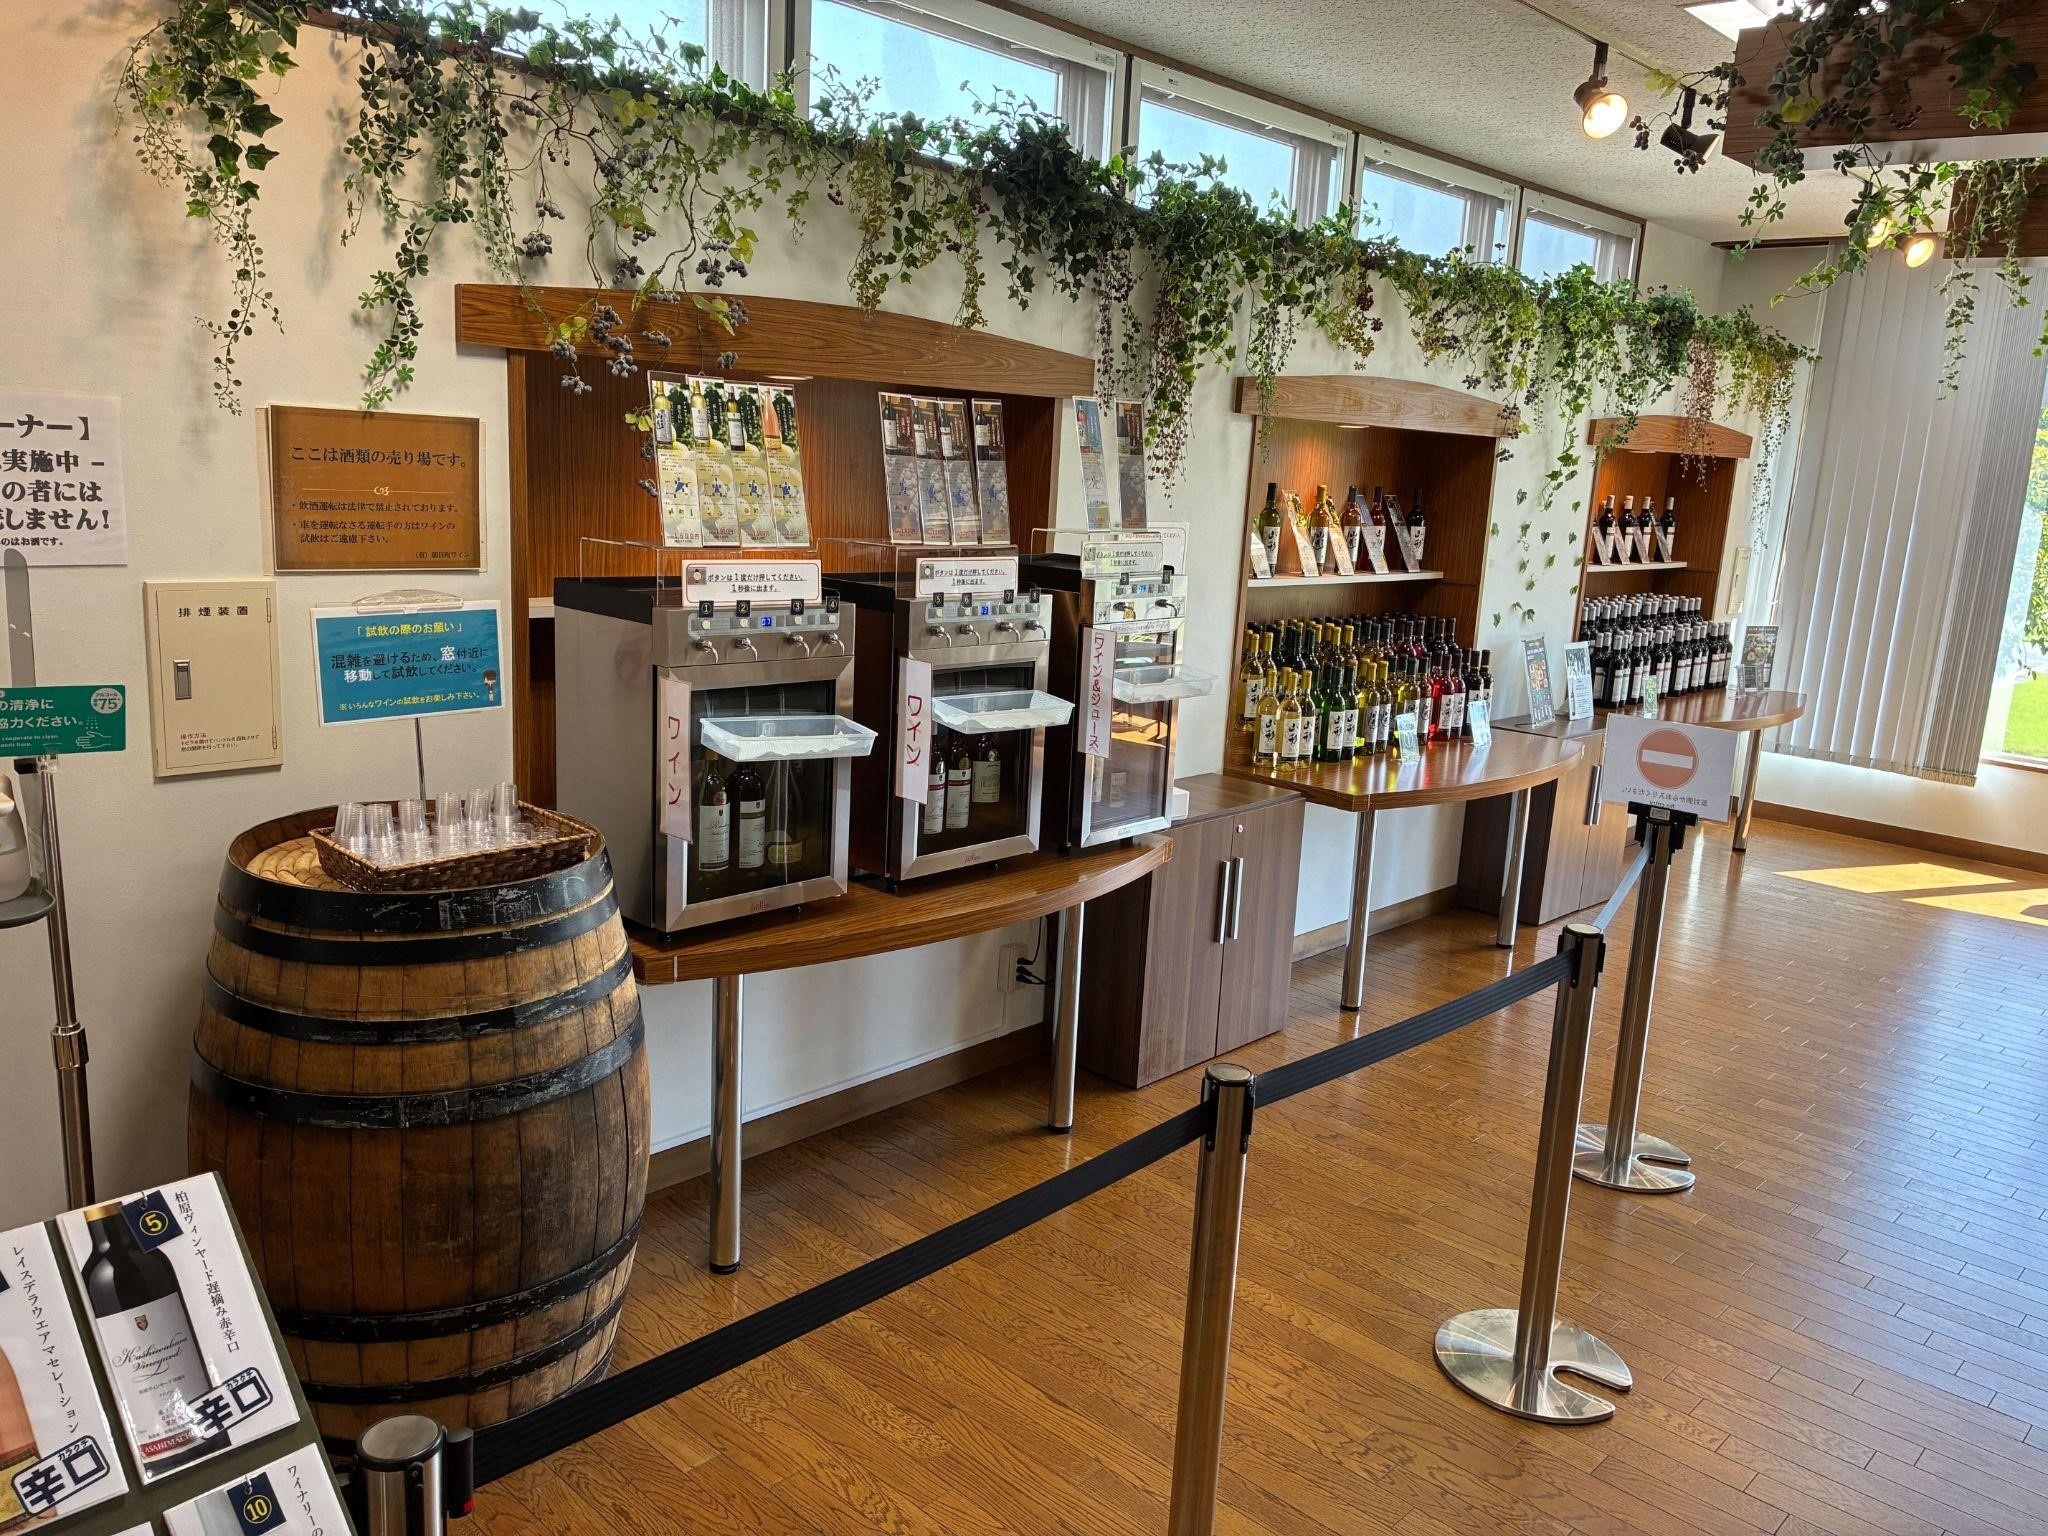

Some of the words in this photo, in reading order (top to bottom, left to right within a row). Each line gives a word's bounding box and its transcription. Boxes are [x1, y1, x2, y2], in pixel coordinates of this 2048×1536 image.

[291, 447, 467, 468] ここは酒類の売り場です。
[2, 480, 103, 503] の者には
[178, 605, 248, 618] 排煙装置
[357, 622, 463, 637] 「試飲の際のお願い」
[344, 665, 477, 683] 移動して試飲してください。
[906, 694, 922, 766] ワイン
[668, 716, 682, 806] ワイン
[175, 1190, 240, 1353] 柏原ヴィンヤード遅摘み赤辛口
[224, 1369, 254, 1391] カラクチ
[192, 1379, 268, 1437] 辛口
[58, 1439, 89, 1461] カラクチ
[20, 1444, 106, 1507] 辛口
